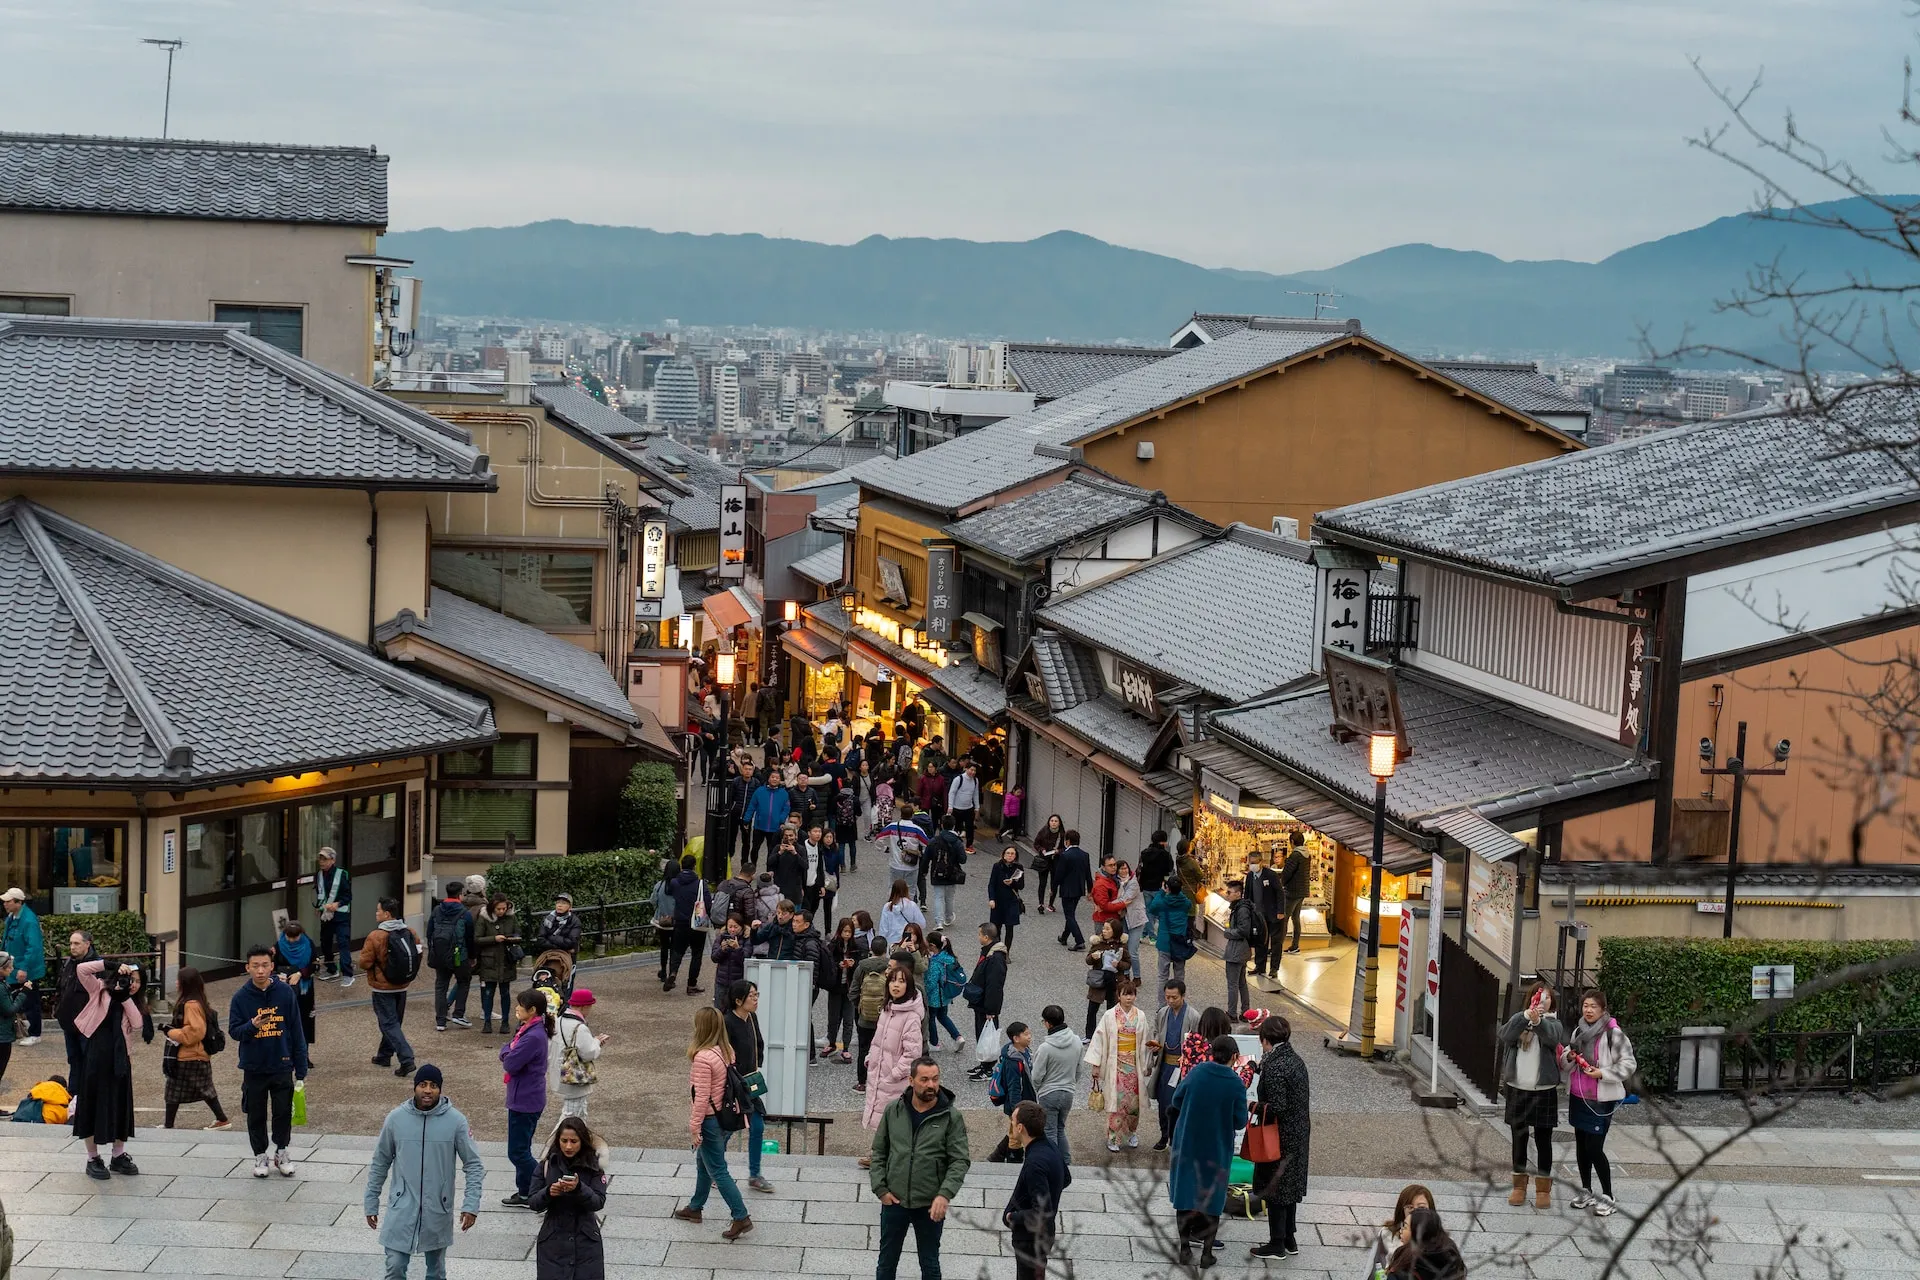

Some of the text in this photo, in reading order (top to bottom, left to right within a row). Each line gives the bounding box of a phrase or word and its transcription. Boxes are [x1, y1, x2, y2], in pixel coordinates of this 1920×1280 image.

[931, 595, 948, 633] 西利
[1702, 903, 1725, 912] 立入禁
[1396, 908, 1411, 1012] KIRIN
